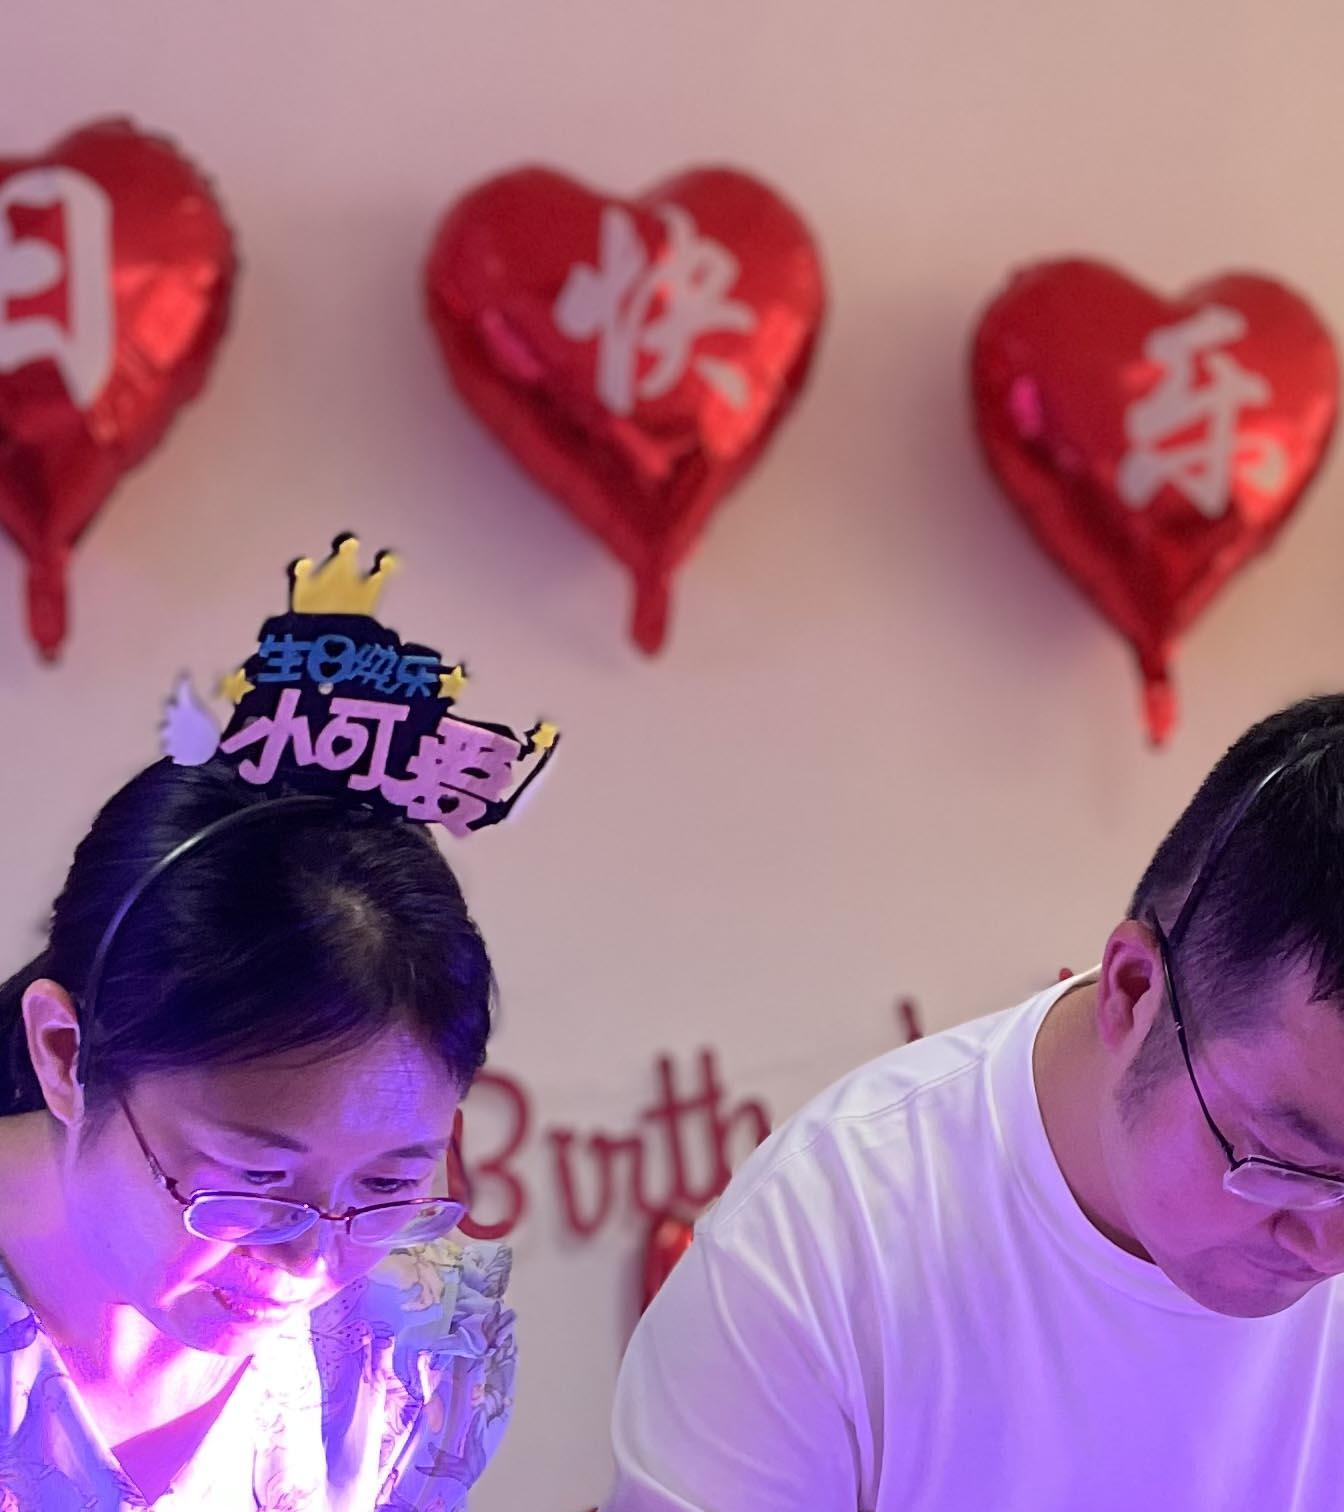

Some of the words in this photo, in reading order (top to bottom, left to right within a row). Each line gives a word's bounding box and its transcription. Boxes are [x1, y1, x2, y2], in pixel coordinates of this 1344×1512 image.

[552, 203, 758, 416] 快
[1116, 305, 1288, 519] 乐
[257, 633, 442, 698] 生日快乐
[220, 688, 522, 838] 小可爱
